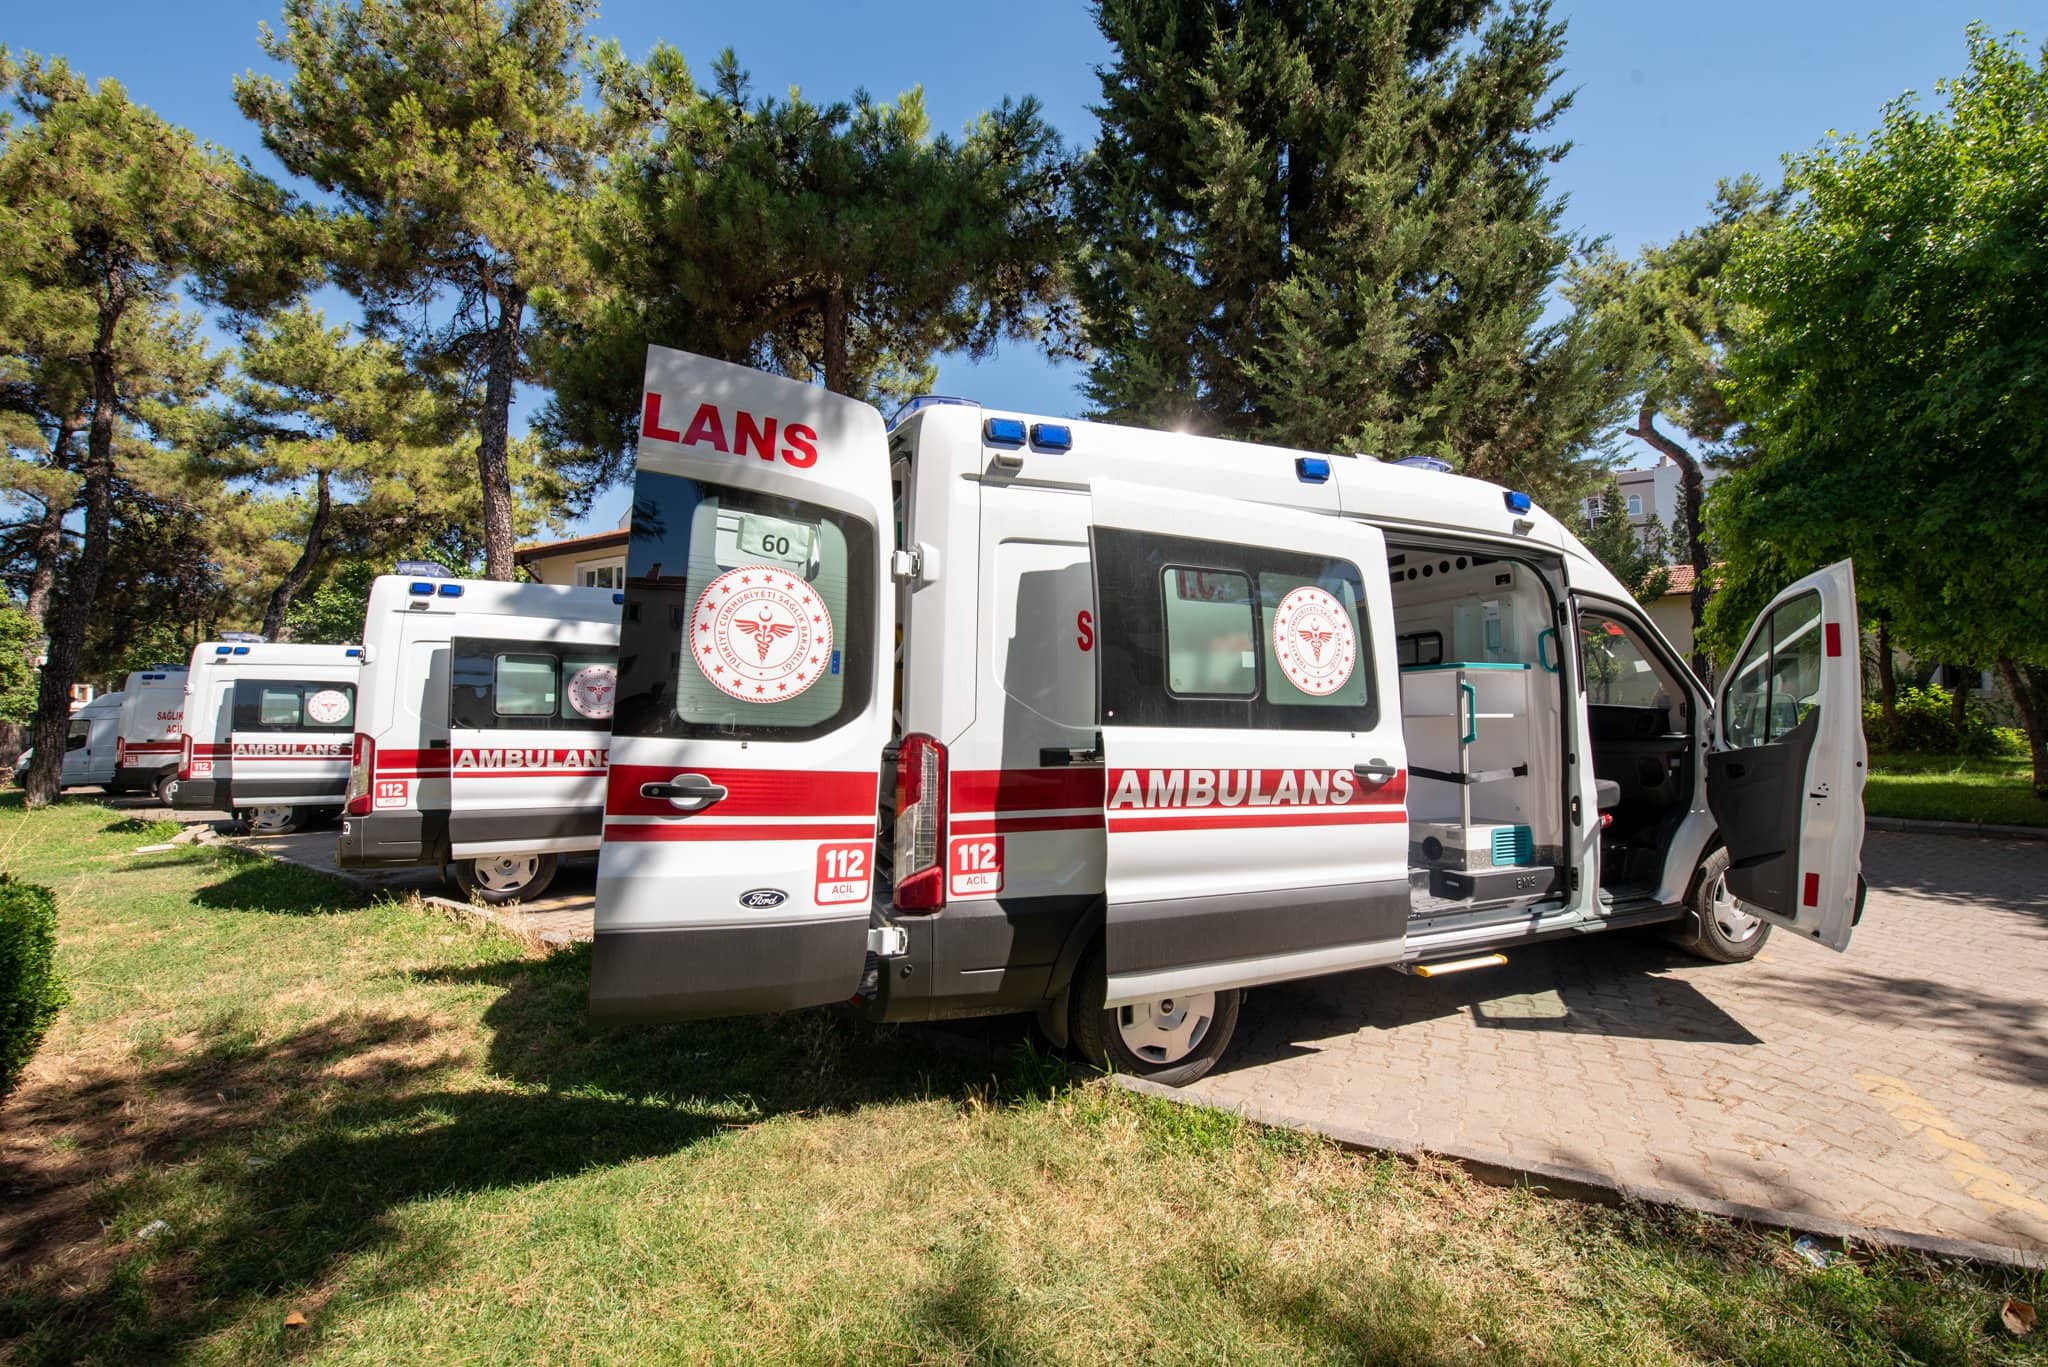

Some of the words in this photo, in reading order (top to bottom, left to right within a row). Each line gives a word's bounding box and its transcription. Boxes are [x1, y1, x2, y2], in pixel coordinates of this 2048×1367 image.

[642, 392, 817, 468] LANS
[762, 534, 789, 555] 60
[720, 591, 776, 626] CUMHURİYETİ
[1077, 610, 1093, 651] S
[719, 630, 742, 669] TÜRKİYE
[234, 744, 341, 755] AMBULANS
[193, 763, 209, 771] 112
[380, 783, 404, 797] 112
[1109, 770, 1354, 809] AMBULANS
[825, 849, 865, 878] 112
[958, 843, 996, 871] 112
[832, 881, 855, 894] ACİL
[966, 873, 989, 886] ACİL
[749, 893, 778, 905] Ford
